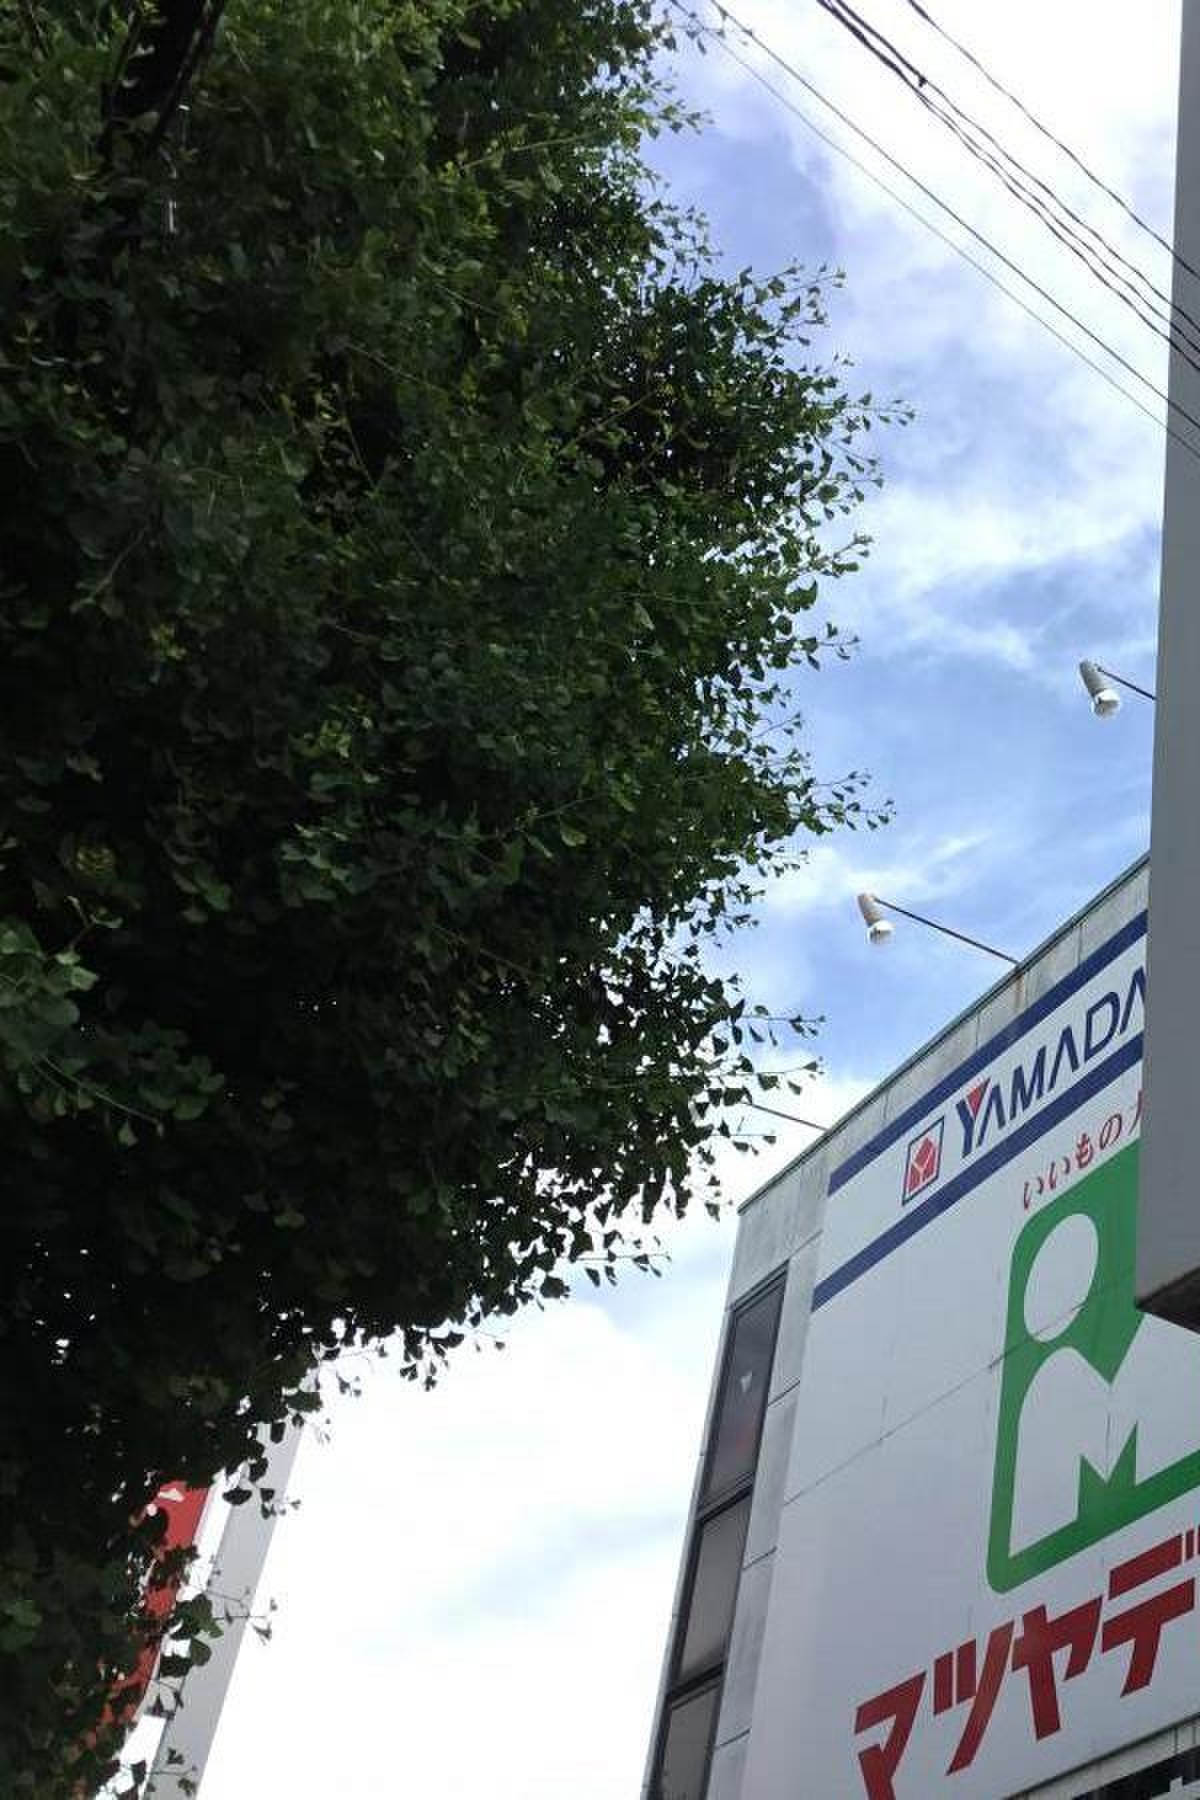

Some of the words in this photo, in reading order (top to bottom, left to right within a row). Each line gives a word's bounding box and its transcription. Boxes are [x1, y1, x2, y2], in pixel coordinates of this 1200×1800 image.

[956, 966, 1146, 1158] YAMADA
[1023, 1090, 1143, 1210] いいもの
